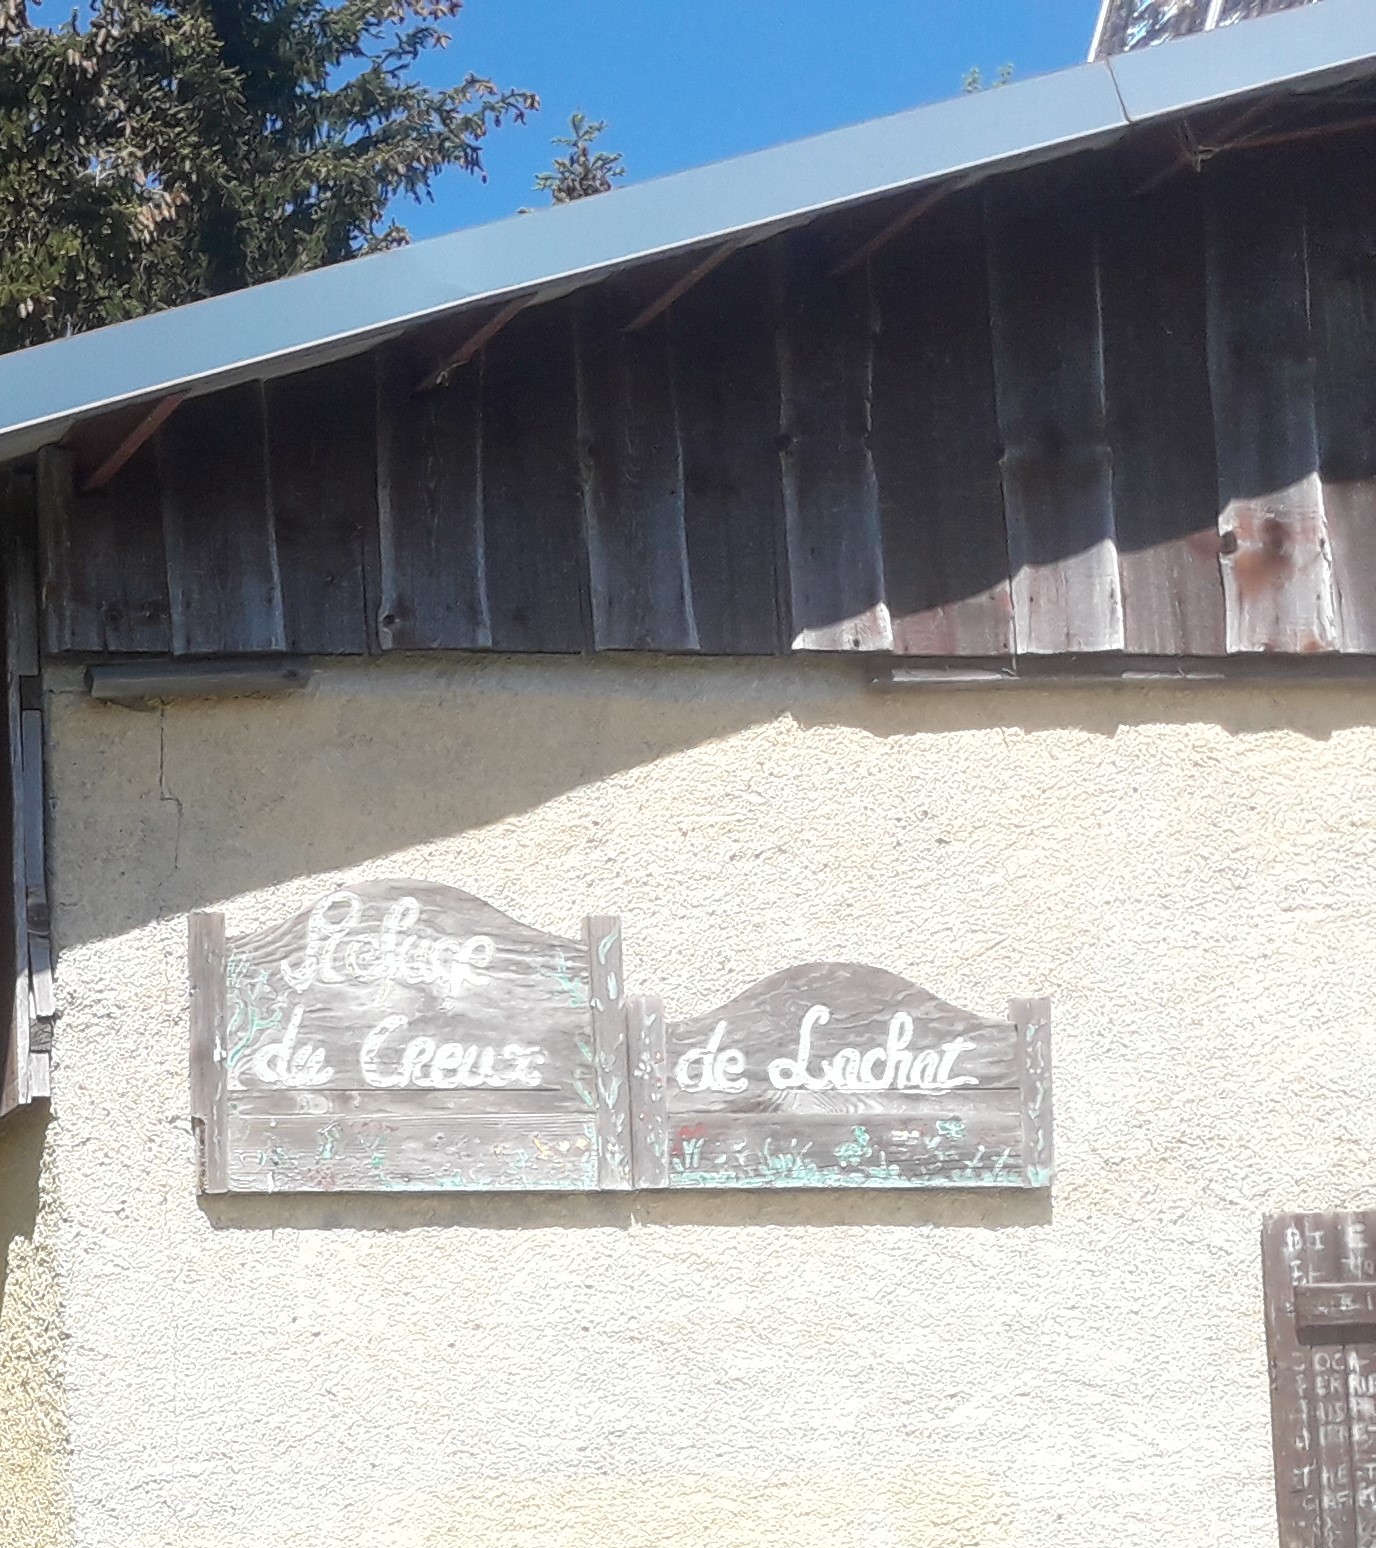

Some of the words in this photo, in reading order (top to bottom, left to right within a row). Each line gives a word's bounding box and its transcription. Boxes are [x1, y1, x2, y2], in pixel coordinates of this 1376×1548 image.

[281, 891, 496, 1004] Refuge
[252, 1004, 337, 1088] du
[360, 1014, 546, 1090] Creux
[674, 1019, 749, 1093] de
[767, 1003, 981, 1095] Lachat
